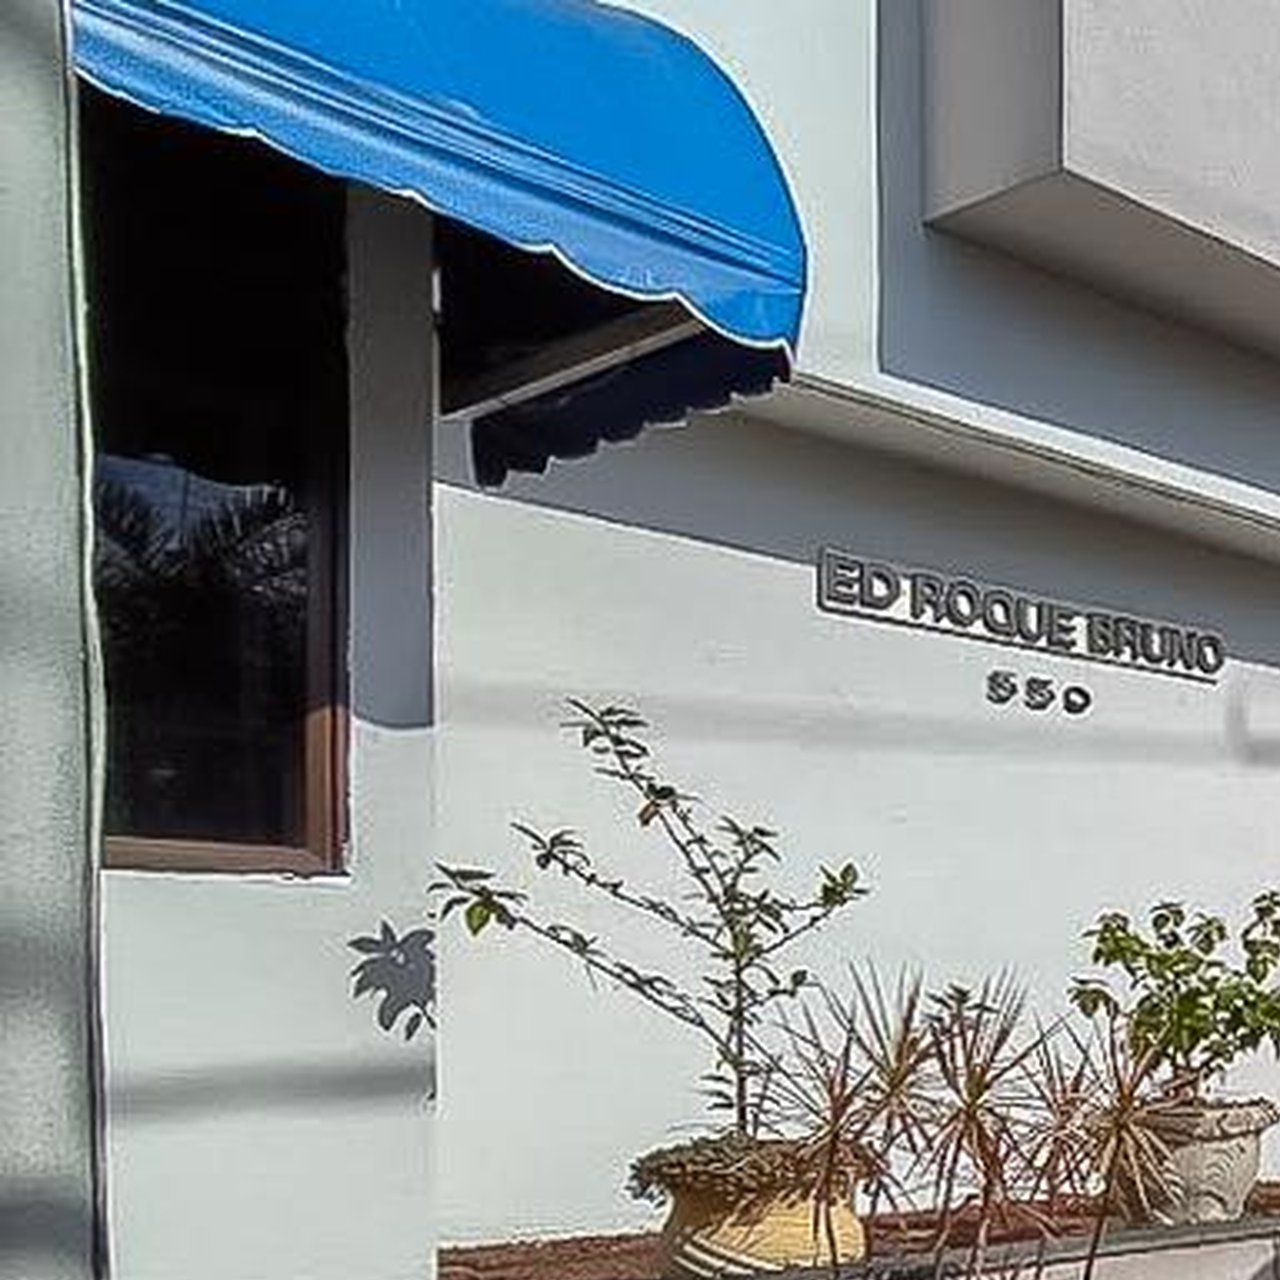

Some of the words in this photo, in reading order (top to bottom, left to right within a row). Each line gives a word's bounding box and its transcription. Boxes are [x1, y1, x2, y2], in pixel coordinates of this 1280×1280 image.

[823, 551, 901, 610] ED
[909, 573, 1078, 650] ROQUE
[1086, 614, 1226, 674] BRUNO
[986, 670, 1092, 714] 550
